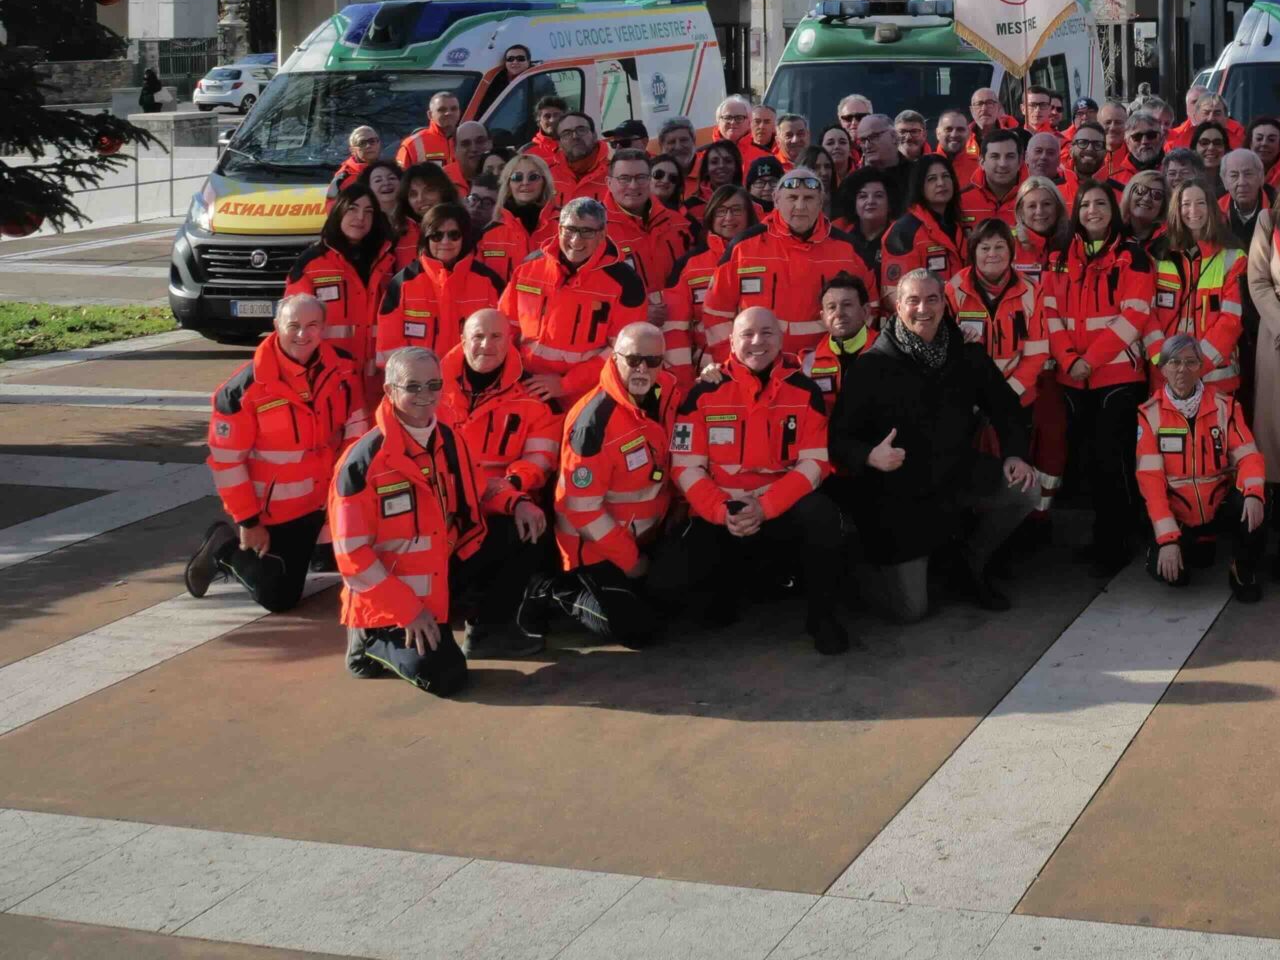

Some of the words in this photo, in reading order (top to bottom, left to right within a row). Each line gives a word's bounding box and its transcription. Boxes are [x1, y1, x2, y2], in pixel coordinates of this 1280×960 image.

[550, 31, 573, 50] ODV
[575, 26, 613, 46] CROCE
[614, 23, 649, 43] VERDE
[649, 20, 687, 39] MESTRE
[996, 17, 1037, 36] MESTRE
[653, 82, 665, 95] 118
